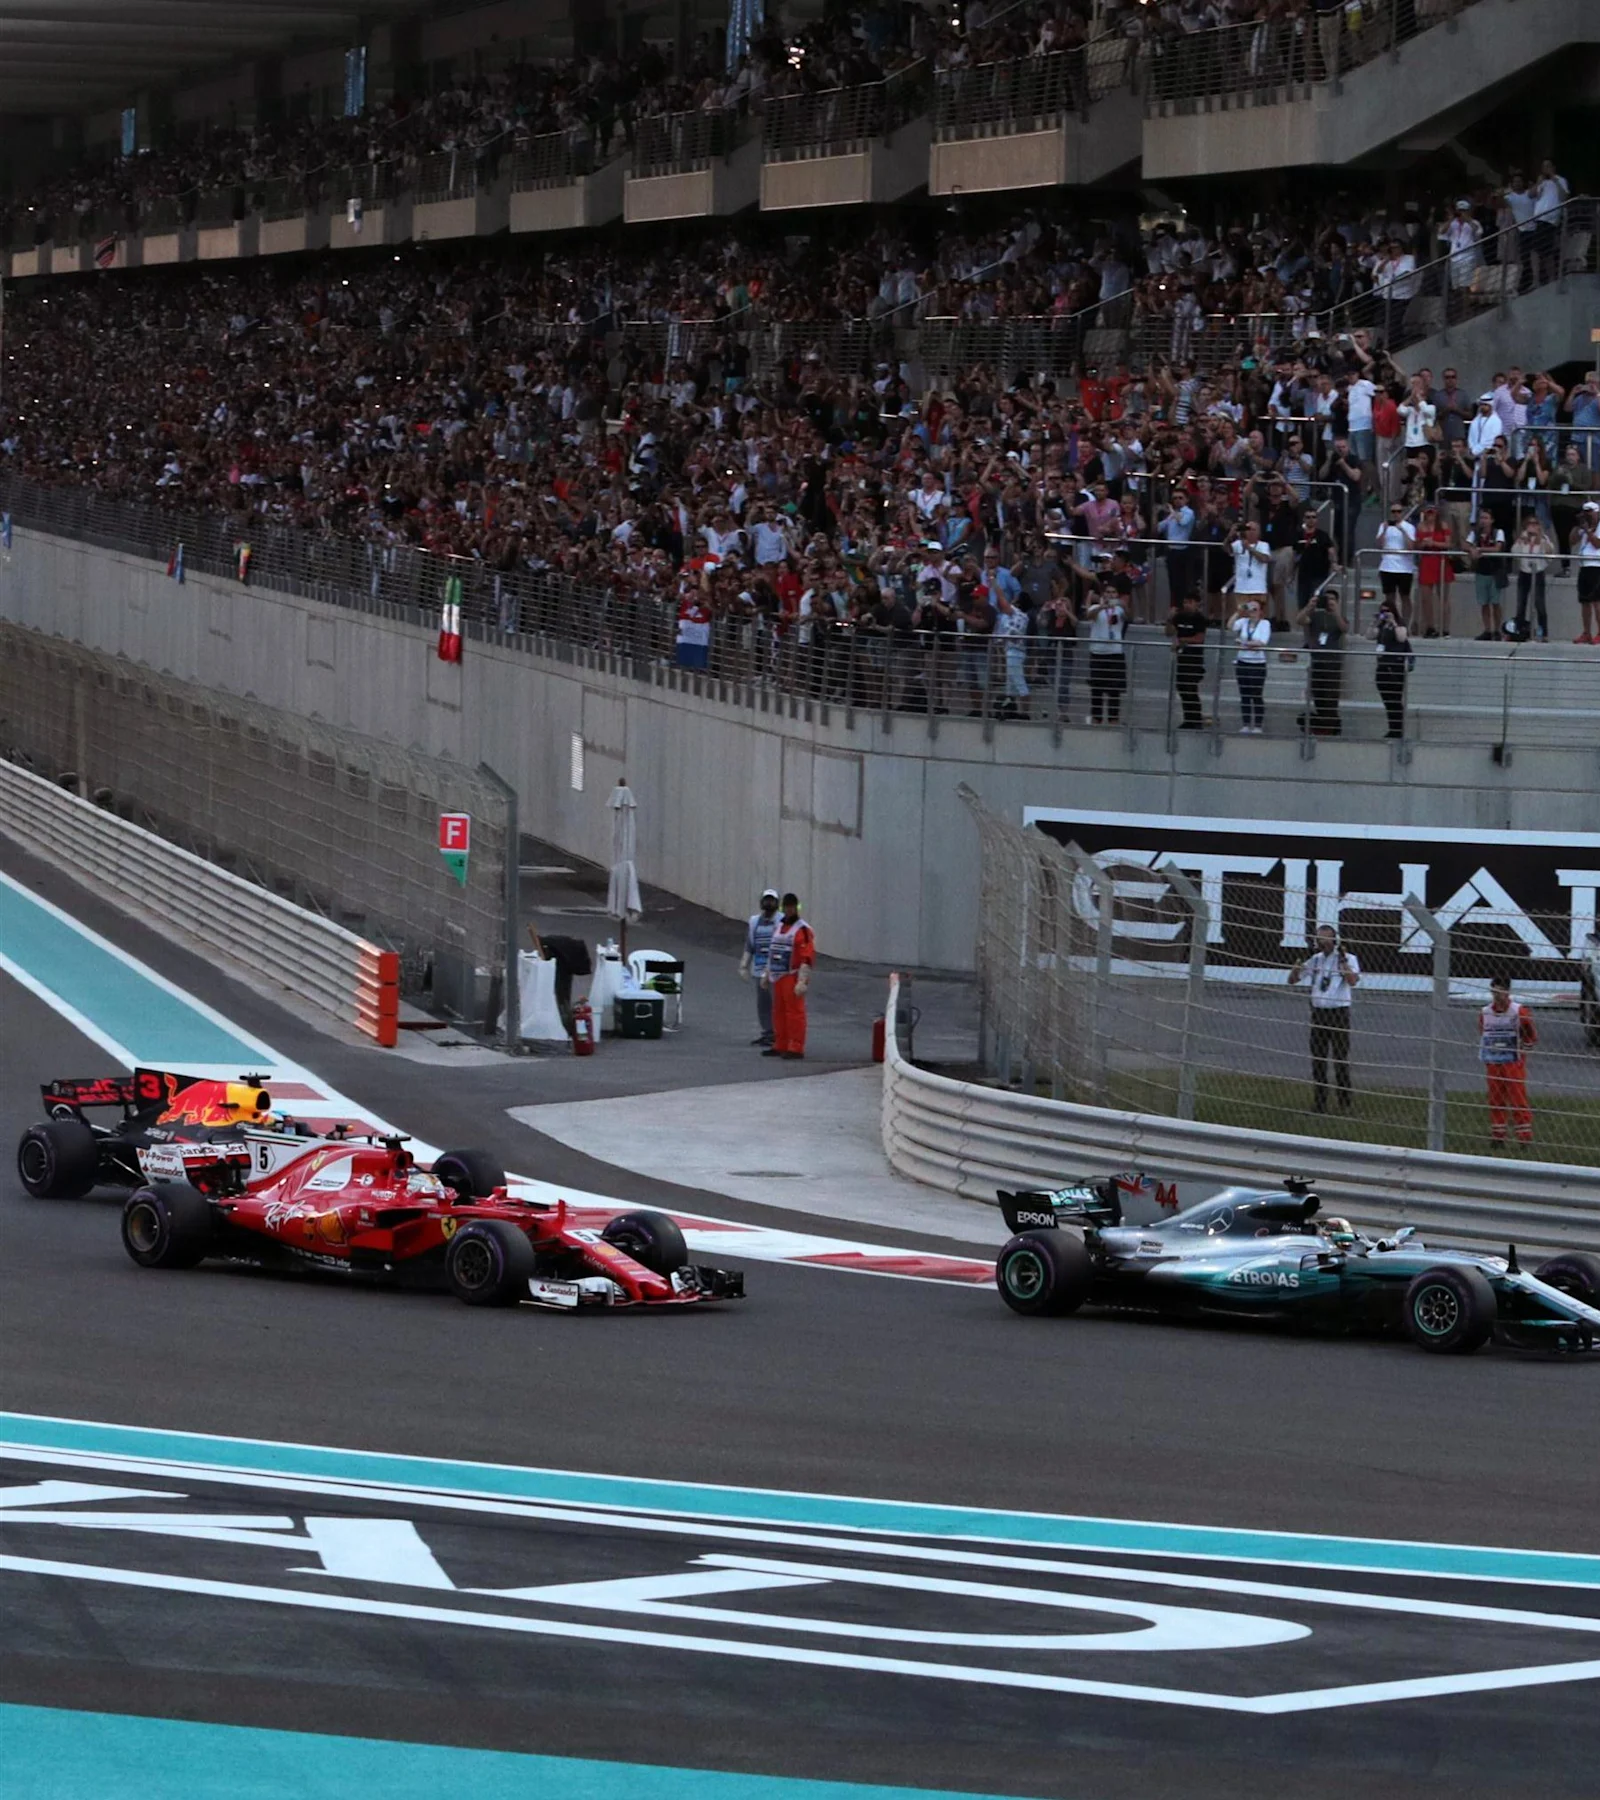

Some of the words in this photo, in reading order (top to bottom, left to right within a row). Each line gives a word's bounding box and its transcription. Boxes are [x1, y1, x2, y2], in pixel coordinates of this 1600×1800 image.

[446, 821, 461, 846] F
[140, 1073, 160, 1100] 3
[260, 1146, 268, 1170] 5
[150, 1163, 184, 1177] Santander
[1155, 1182, 1178, 1210] 44
[1017, 1211, 1055, 1227] EPSON
[1227, 1268, 1300, 1288] PETRONAS
[546, 1283, 577, 1297] Santander
